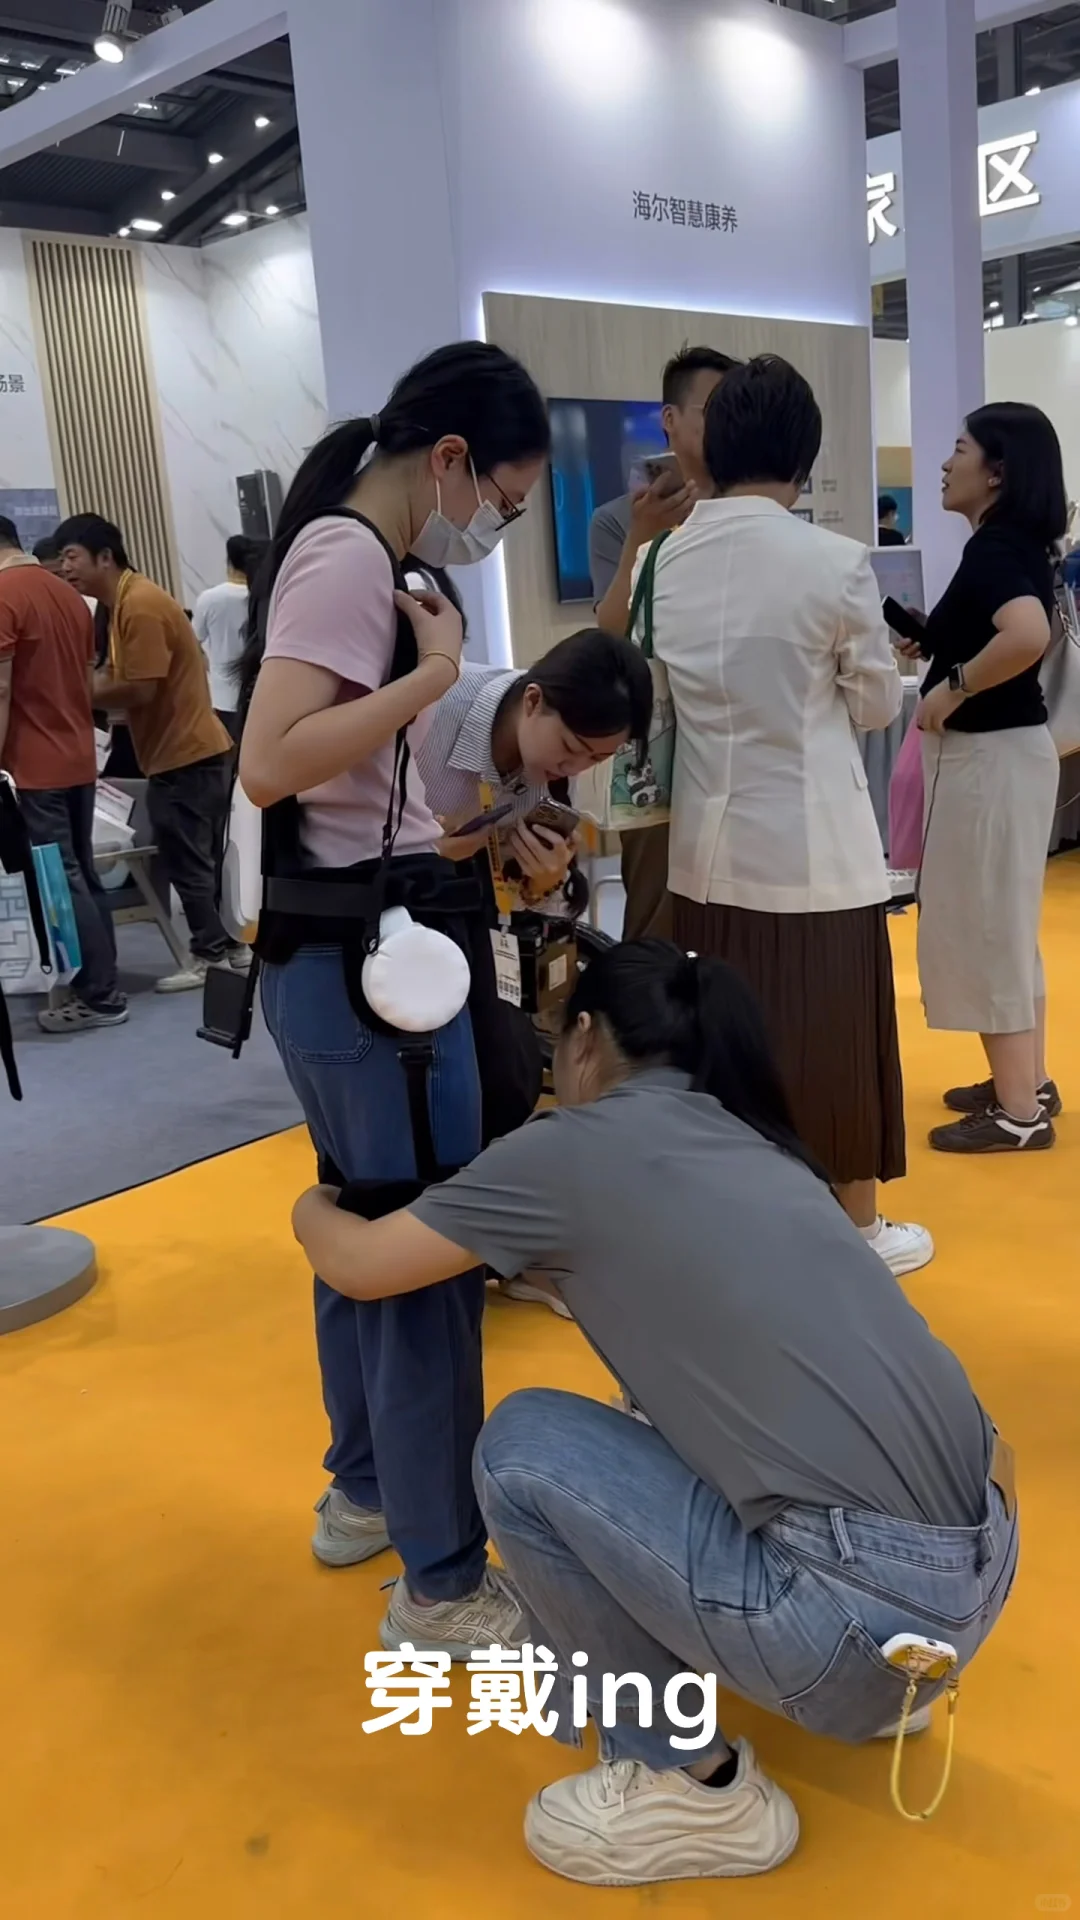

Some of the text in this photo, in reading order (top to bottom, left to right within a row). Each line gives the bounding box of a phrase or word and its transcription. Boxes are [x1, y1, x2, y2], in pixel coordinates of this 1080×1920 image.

[632, 190, 738, 233] 海尔智慧康养
